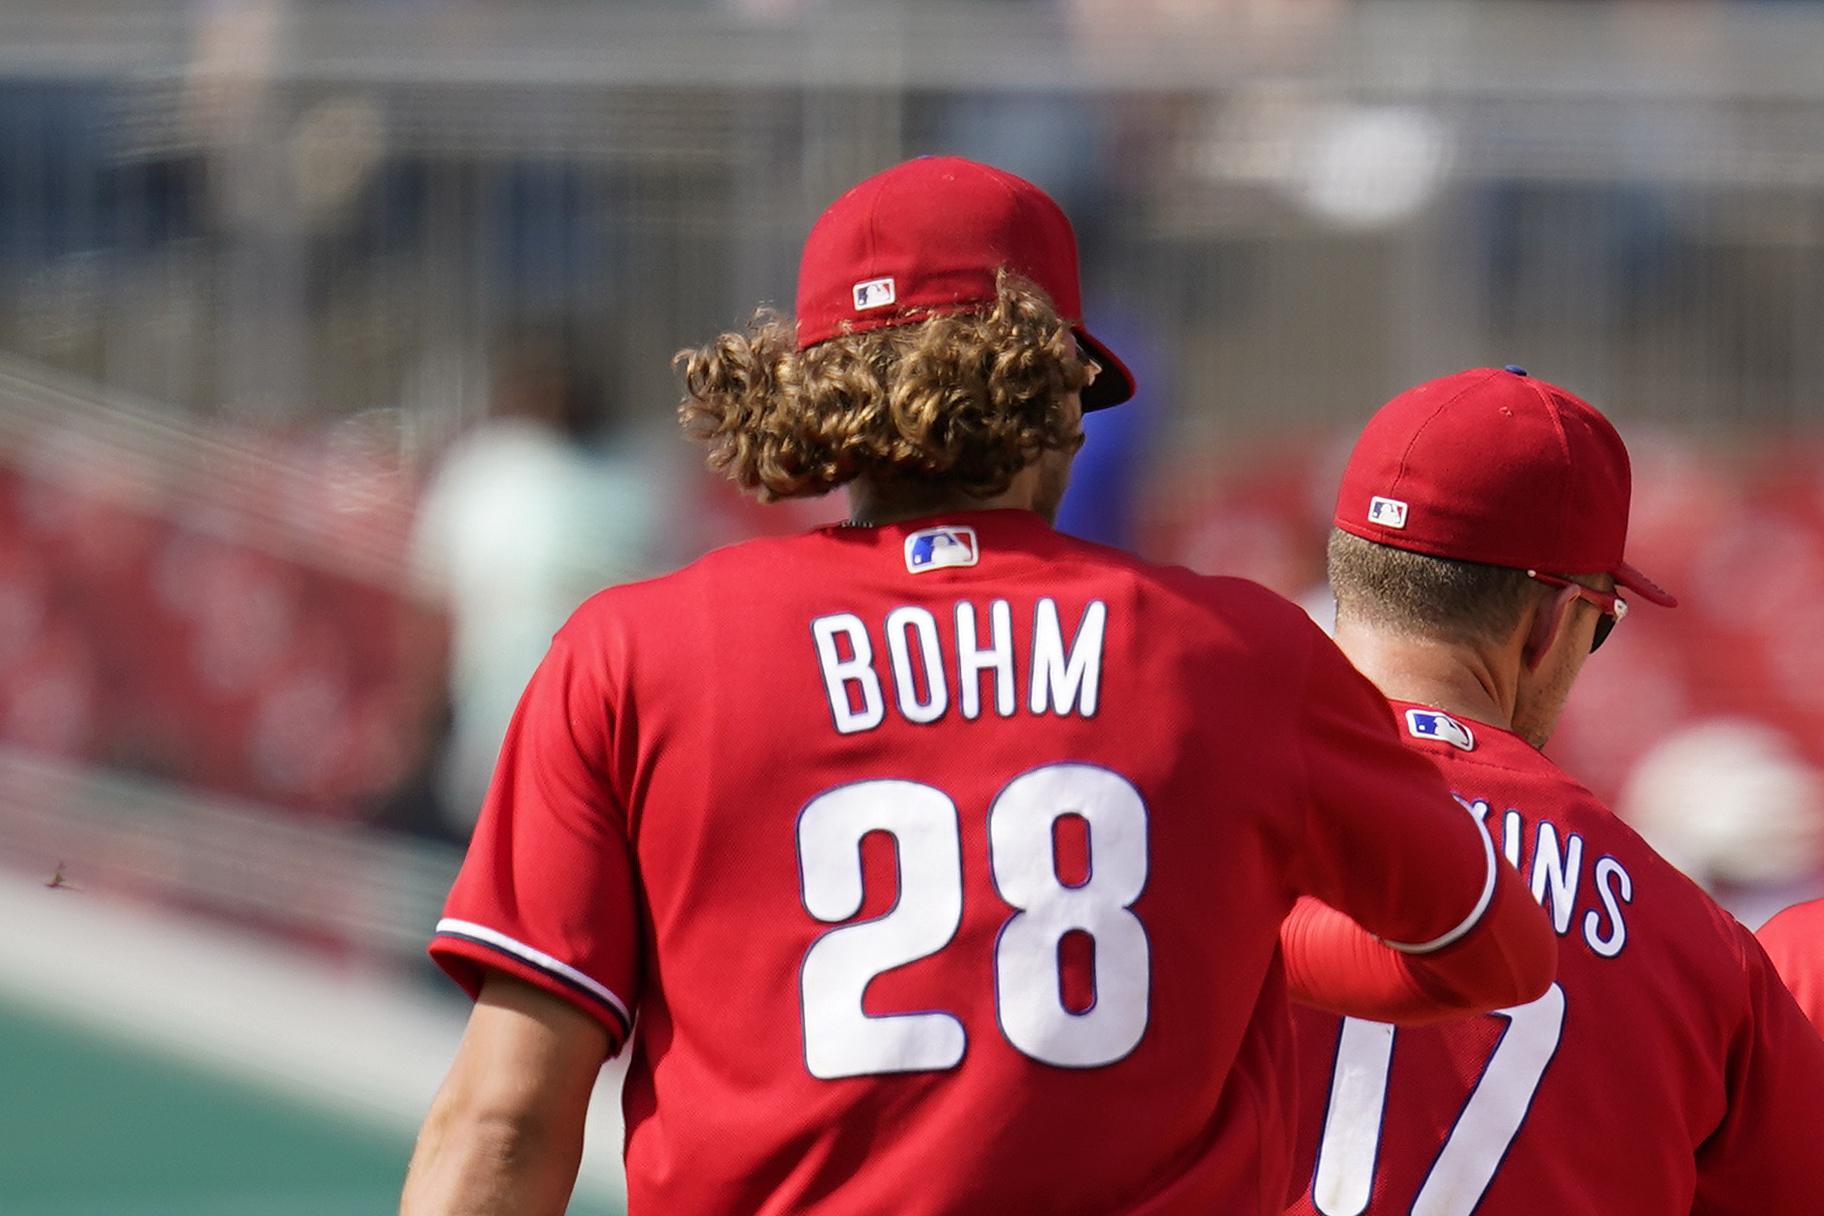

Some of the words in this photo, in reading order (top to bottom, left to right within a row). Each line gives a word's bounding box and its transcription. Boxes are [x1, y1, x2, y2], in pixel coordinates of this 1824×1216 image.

[809, 597, 1108, 735] BOHM
[794, 759, 1153, 1082] 28
[1471, 797, 1633, 958] INS
